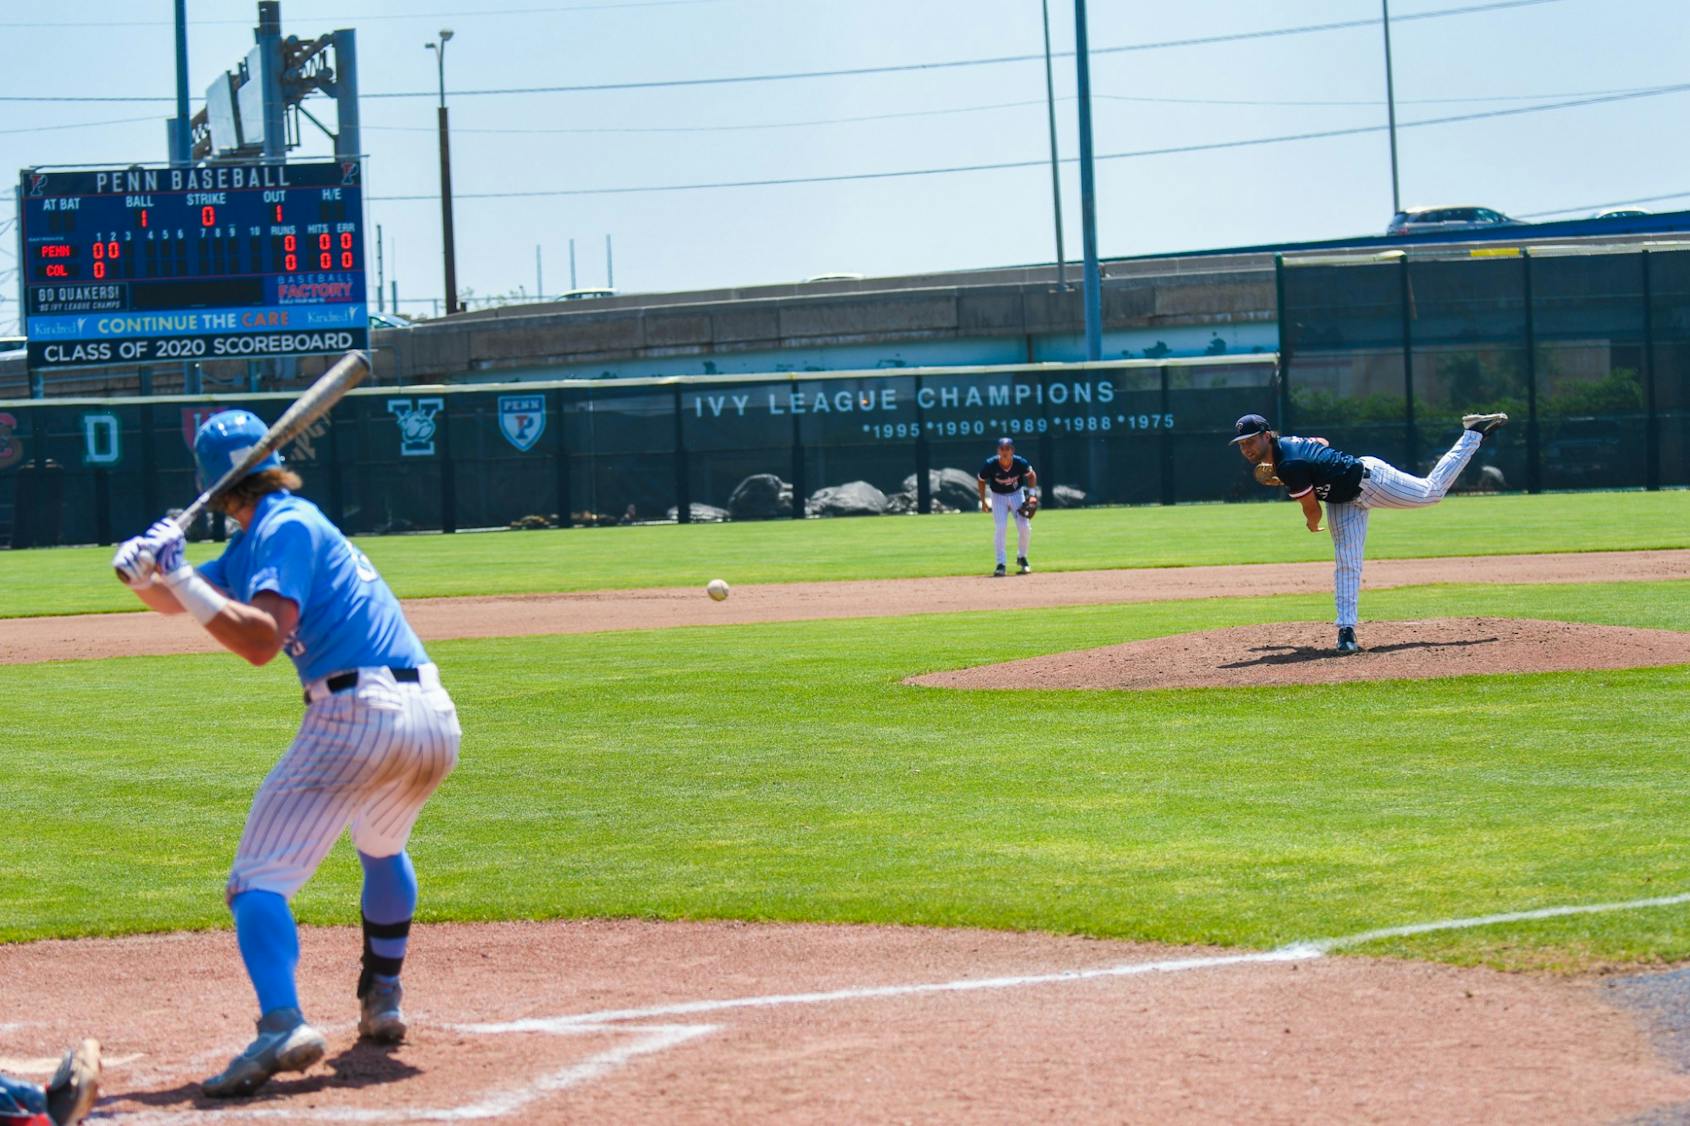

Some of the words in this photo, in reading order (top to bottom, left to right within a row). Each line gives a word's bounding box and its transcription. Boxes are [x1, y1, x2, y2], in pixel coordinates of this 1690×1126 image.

[97, 171, 157, 193] PENN
[172, 167, 290, 191] BASEBALL
[126, 195, 154, 208] BALL
[186, 192, 227, 206] STRIKE
[263, 190, 286, 203] OUT
[322, 188, 342, 201] H/E
[43, 199, 55, 211] AT
[60, 198, 80, 210] BAT
[275, 204, 283, 223] 1
[141, 209, 148, 228] 1
[202, 206, 215, 227] 0
[96, 233, 102, 241] 1
[110, 232, 117, 241] 2
[125, 231, 132, 241] 3
[147, 230, 154, 239] 4
[162, 230, 169, 239] 5
[177, 229, 184, 239] 6
[200, 228, 207, 238] 7
[215, 228, 221, 238] 8
[229, 227, 236, 238] 9
[250, 226, 261, 237] 10
[270, 225, 296, 236] RUNS
[307, 223, 329, 234] HITS
[337, 222, 355, 233] ERR
[41, 245, 70, 258] PENN
[93, 242, 104, 259] 0
[108, 241, 120, 259] 0
[284, 235, 296, 252] 0
[319, 233, 331, 250] 0
[340, 232, 352, 249] 0
[46, 264, 68, 277] COL
[93, 261, 105, 279] 0
[285, 254, 297, 271] 0
[320, 252, 331, 270] 0
[341, 251, 353, 268] 0
[278, 274, 353, 284] BASEBALL
[38, 288, 54, 302] GO
[59, 286, 119, 301] QUAKERS!
[278, 283, 352, 297] FACTORY
[64, 301, 91, 310] LEAGUE
[92, 300, 120, 310] CHAMPS
[98, 315, 197, 334] CONTINUE
[202, 313, 237, 329] THE
[241, 311, 288, 328] CARE
[44, 343, 111, 362] CLASS
[119, 341, 148, 359] OF
[156, 338, 205, 357] 2020
[213, 332, 353, 354] SCOREBOARD
[504, 400, 540, 412] PENN
[693, 394, 748, 417] IVY
[769, 388, 897, 415] LEAGUE
[917, 381, 1114, 409] CHAMPIONS
[515, 415, 534, 440] P
[84, 415, 118, 462] D
